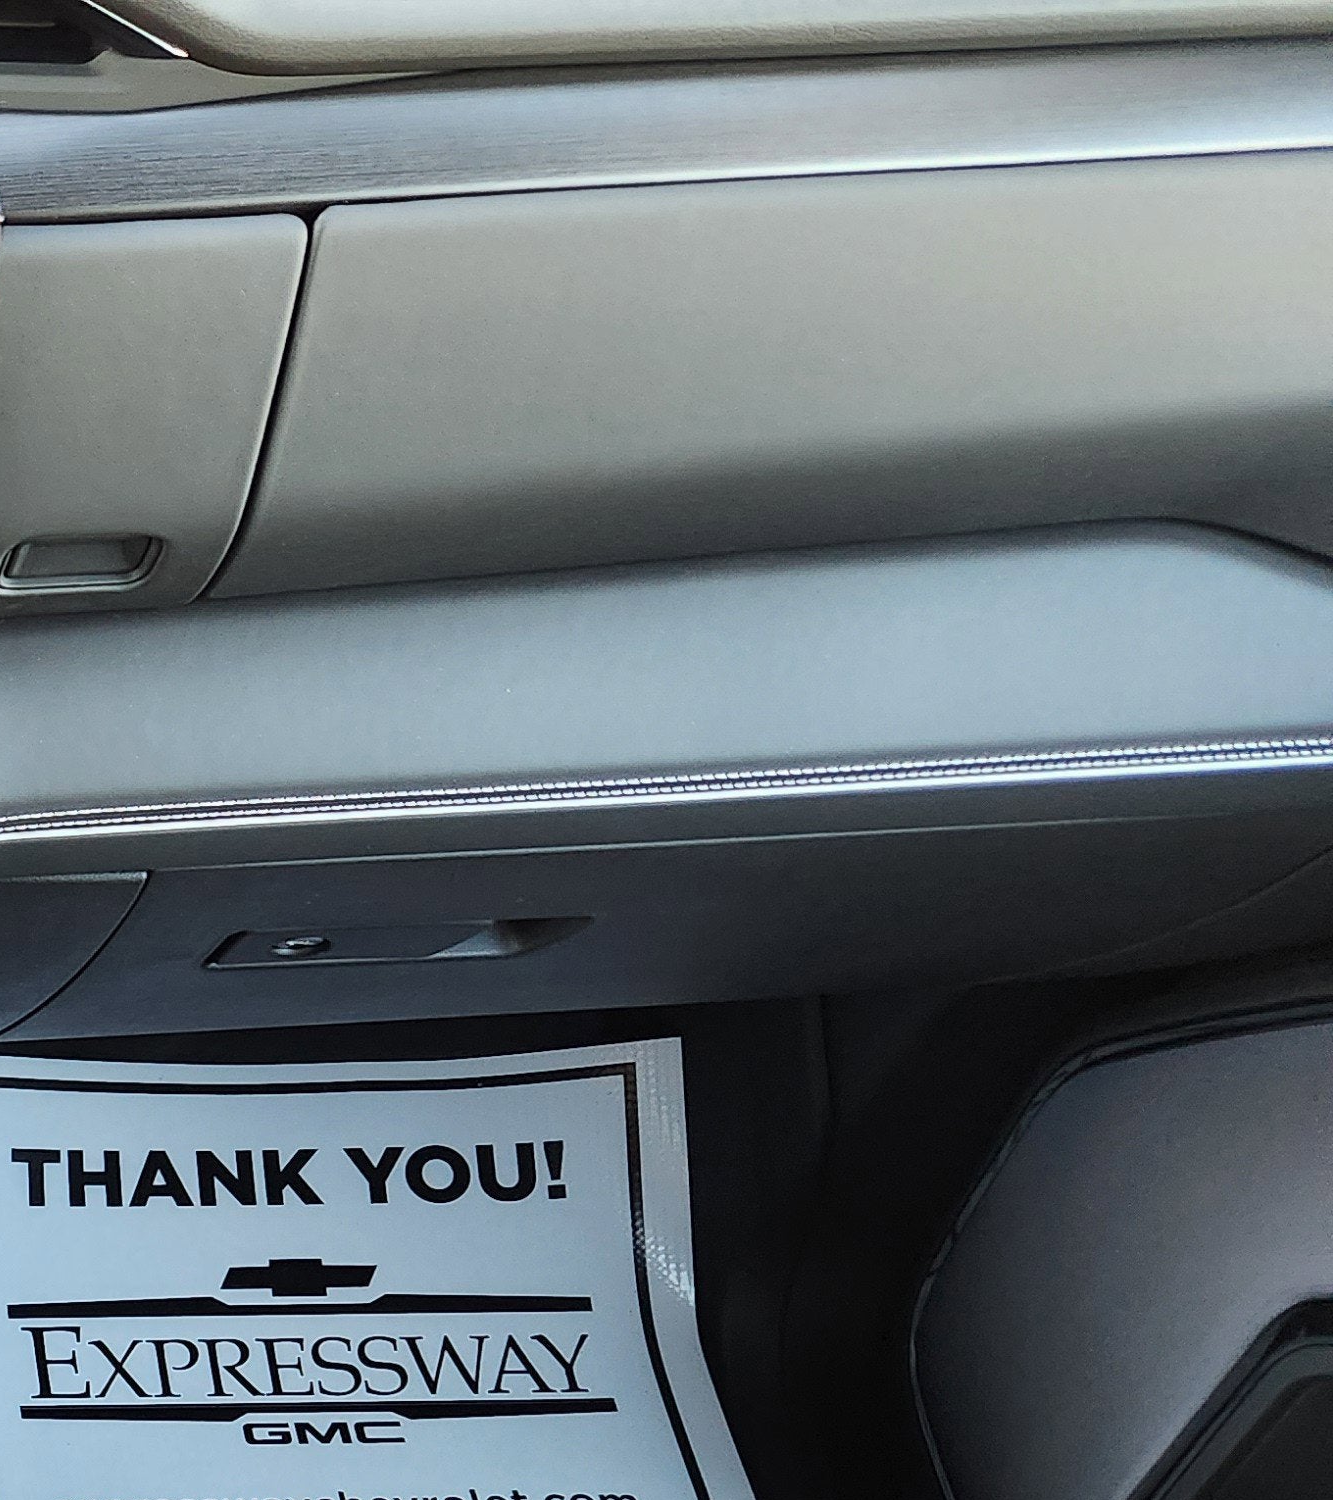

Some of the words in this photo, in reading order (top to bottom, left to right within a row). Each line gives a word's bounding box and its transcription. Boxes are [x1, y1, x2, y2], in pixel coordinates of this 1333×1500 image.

[11, 1148, 324, 1207] THANK
[343, 1140, 568, 1201] YOU!
[20, 1326, 590, 1400] EXPRESSWAY
[242, 1421, 406, 1445] GMC
